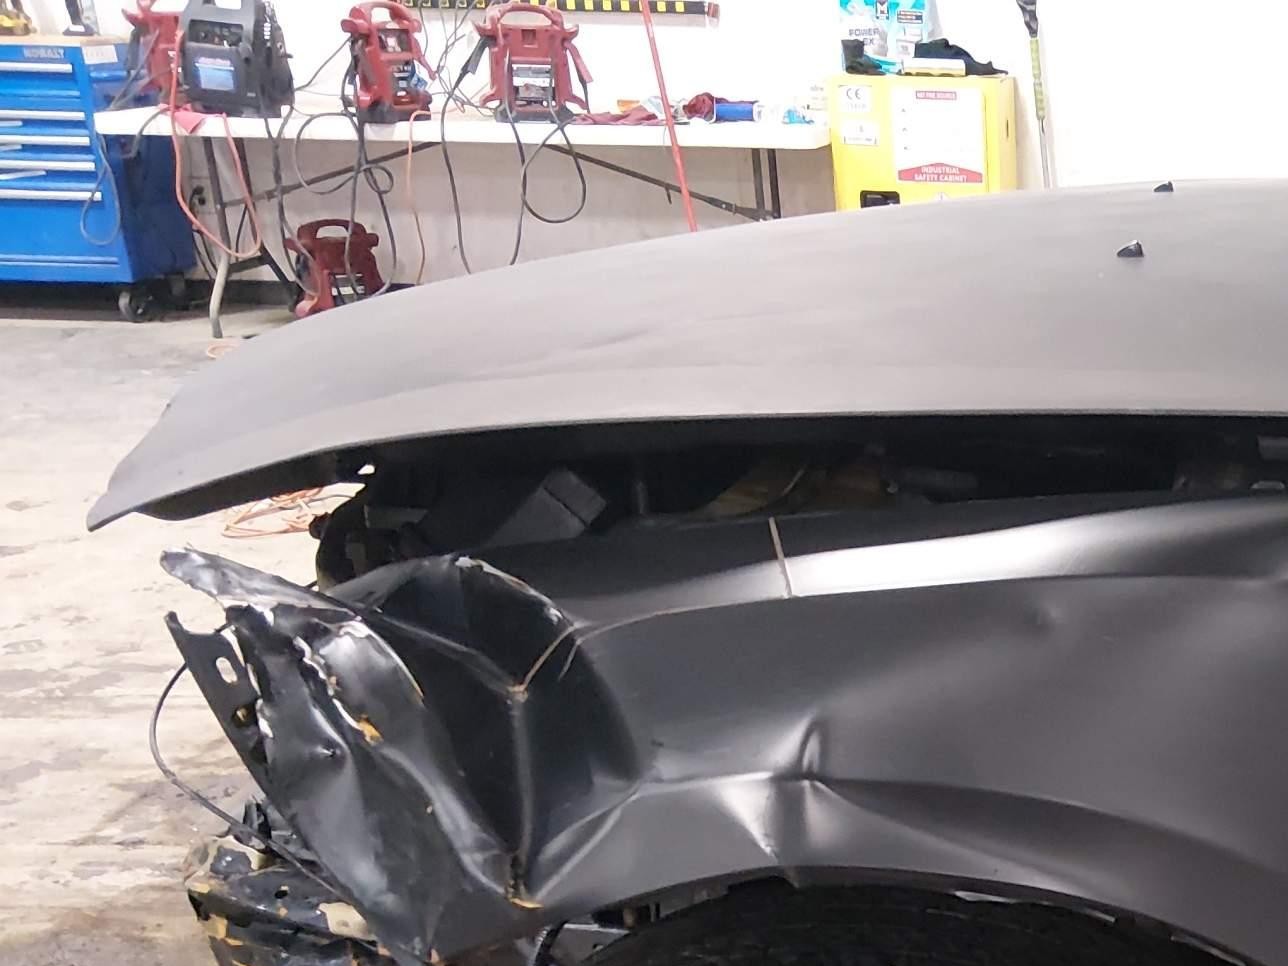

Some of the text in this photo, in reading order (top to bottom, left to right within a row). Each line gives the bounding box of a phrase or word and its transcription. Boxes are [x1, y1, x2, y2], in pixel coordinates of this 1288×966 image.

[848, 28, 880, 37] POWER
[921, 166, 960, 174] INDUSTRIAL
[914, 173, 968, 183] SAFETY CABINET
